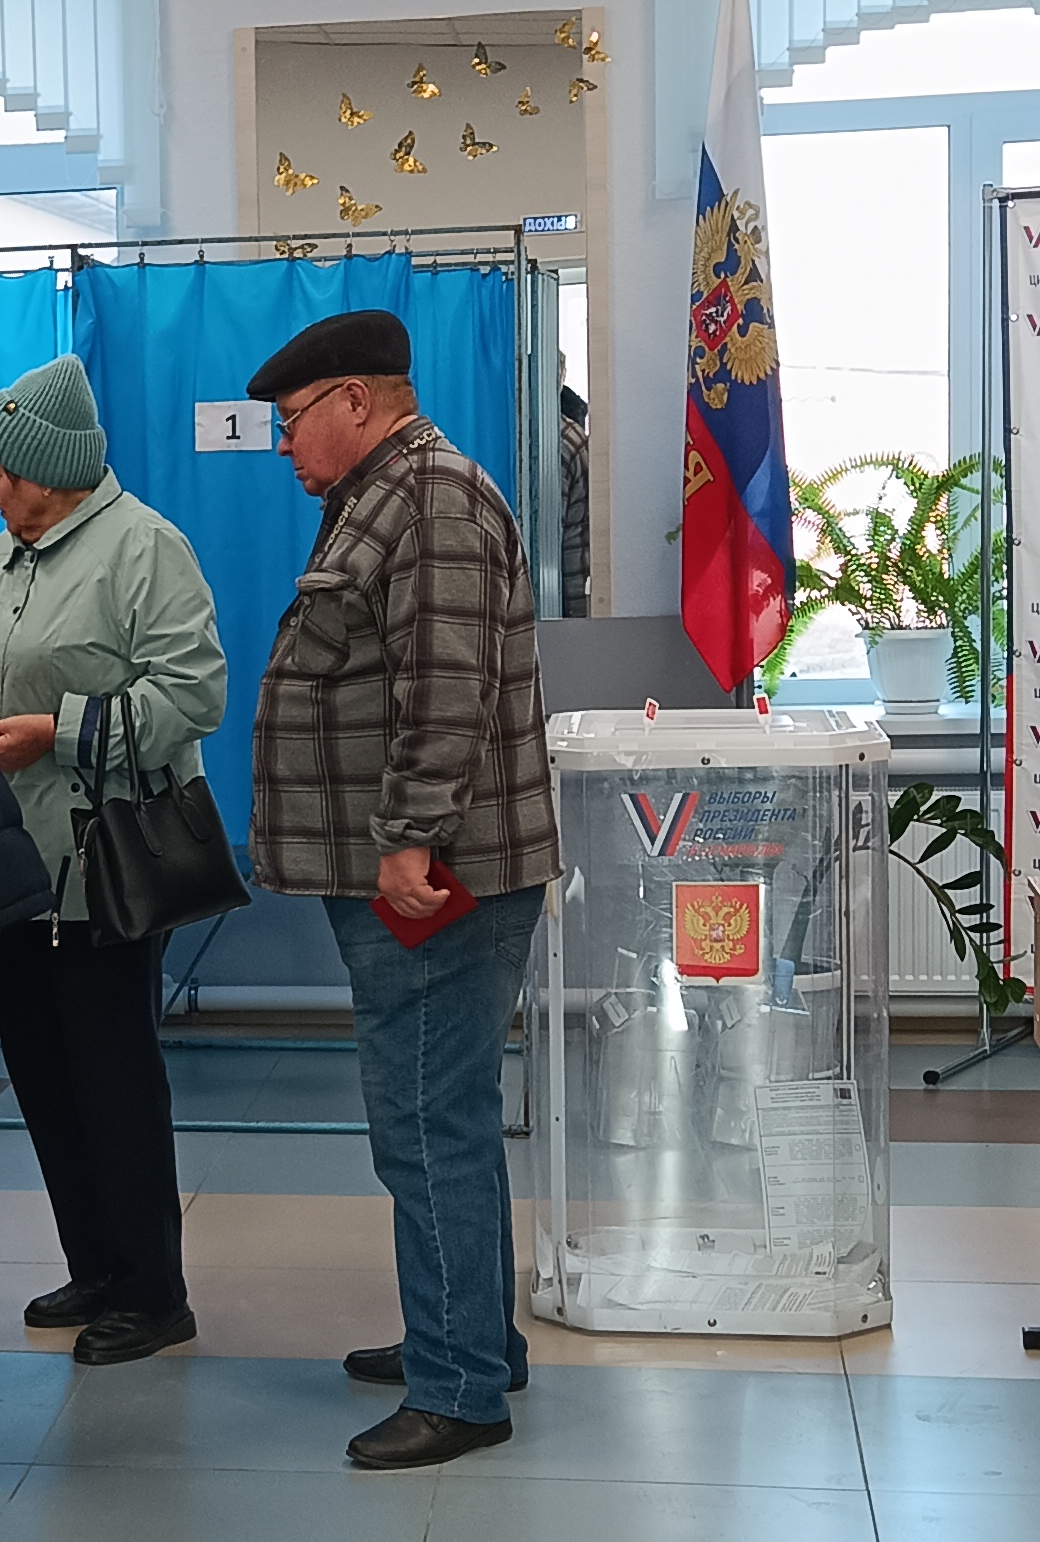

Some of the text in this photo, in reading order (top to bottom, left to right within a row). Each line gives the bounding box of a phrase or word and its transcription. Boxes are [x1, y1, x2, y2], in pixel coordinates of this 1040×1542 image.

[225, 414, 241, 441] 1
[708, 791, 777, 805] ВЫБОРЫ
[699, 808, 797, 824] ПРЕЗИДЕНТА
[692, 827, 755, 841] РОССИИ
